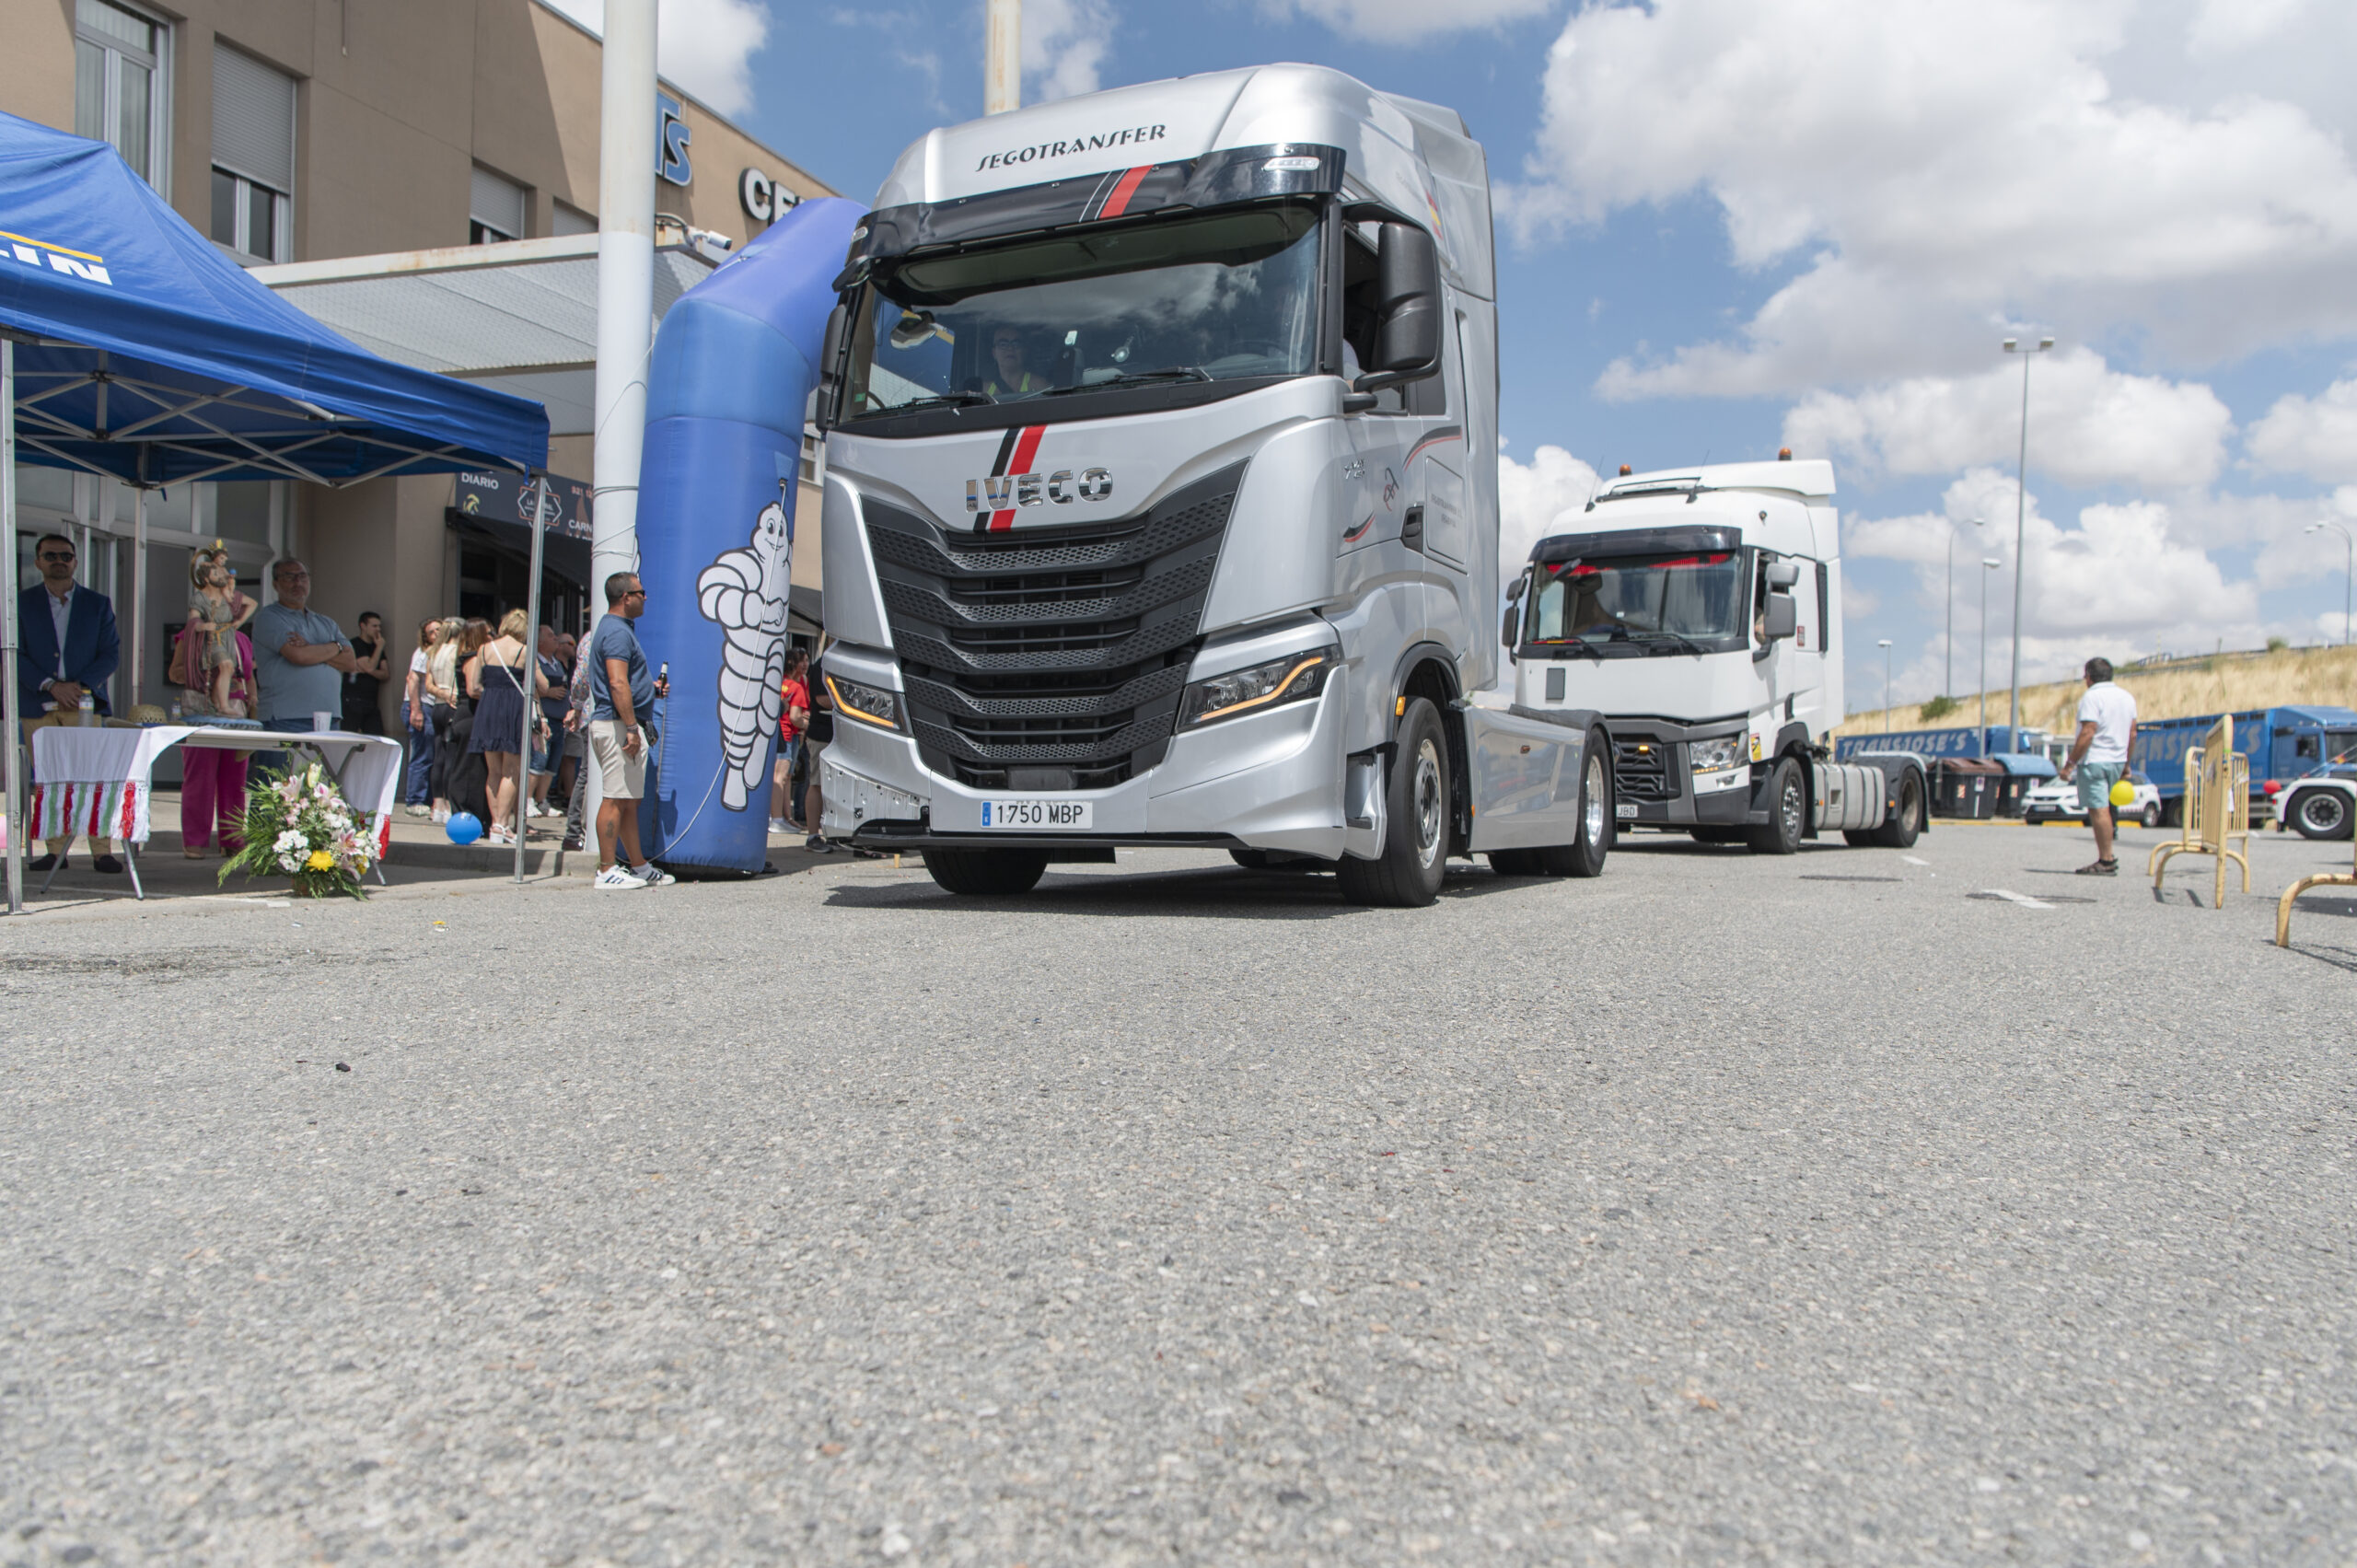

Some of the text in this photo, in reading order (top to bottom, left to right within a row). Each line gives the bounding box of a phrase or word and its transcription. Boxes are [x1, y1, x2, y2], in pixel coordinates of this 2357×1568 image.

[975, 124, 1167, 172] SEGOTRANSFER
[739, 168, 807, 227] CE
[0, 242, 112, 285] IN
[460, 472, 499, 490] DIARIO
[965, 467, 1113, 513] IVECO
[997, 805, 1042, 824] 1750
[1049, 805, 1084, 824] MBP
